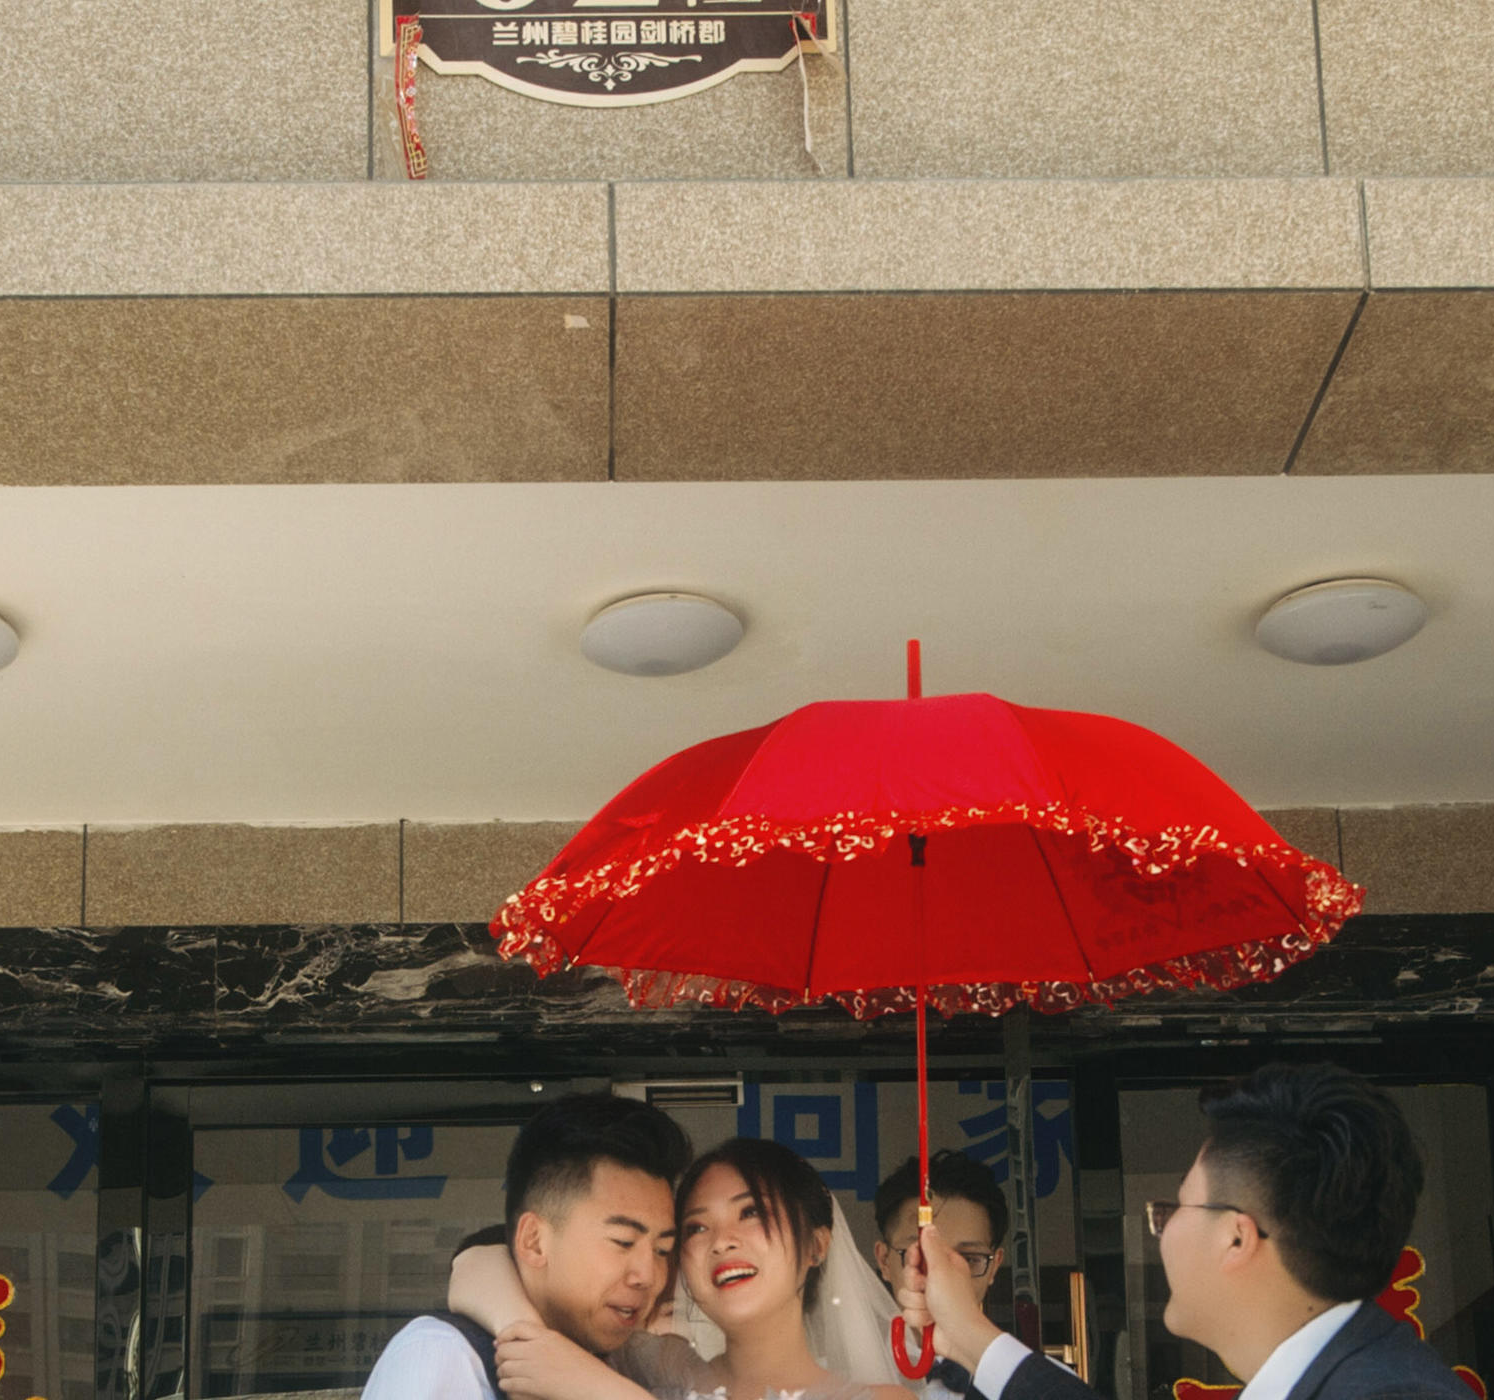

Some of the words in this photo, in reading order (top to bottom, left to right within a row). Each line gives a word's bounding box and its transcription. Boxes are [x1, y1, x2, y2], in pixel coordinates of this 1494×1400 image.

[492, 20, 727, 46] 兰州碧桂园剑桥郡
